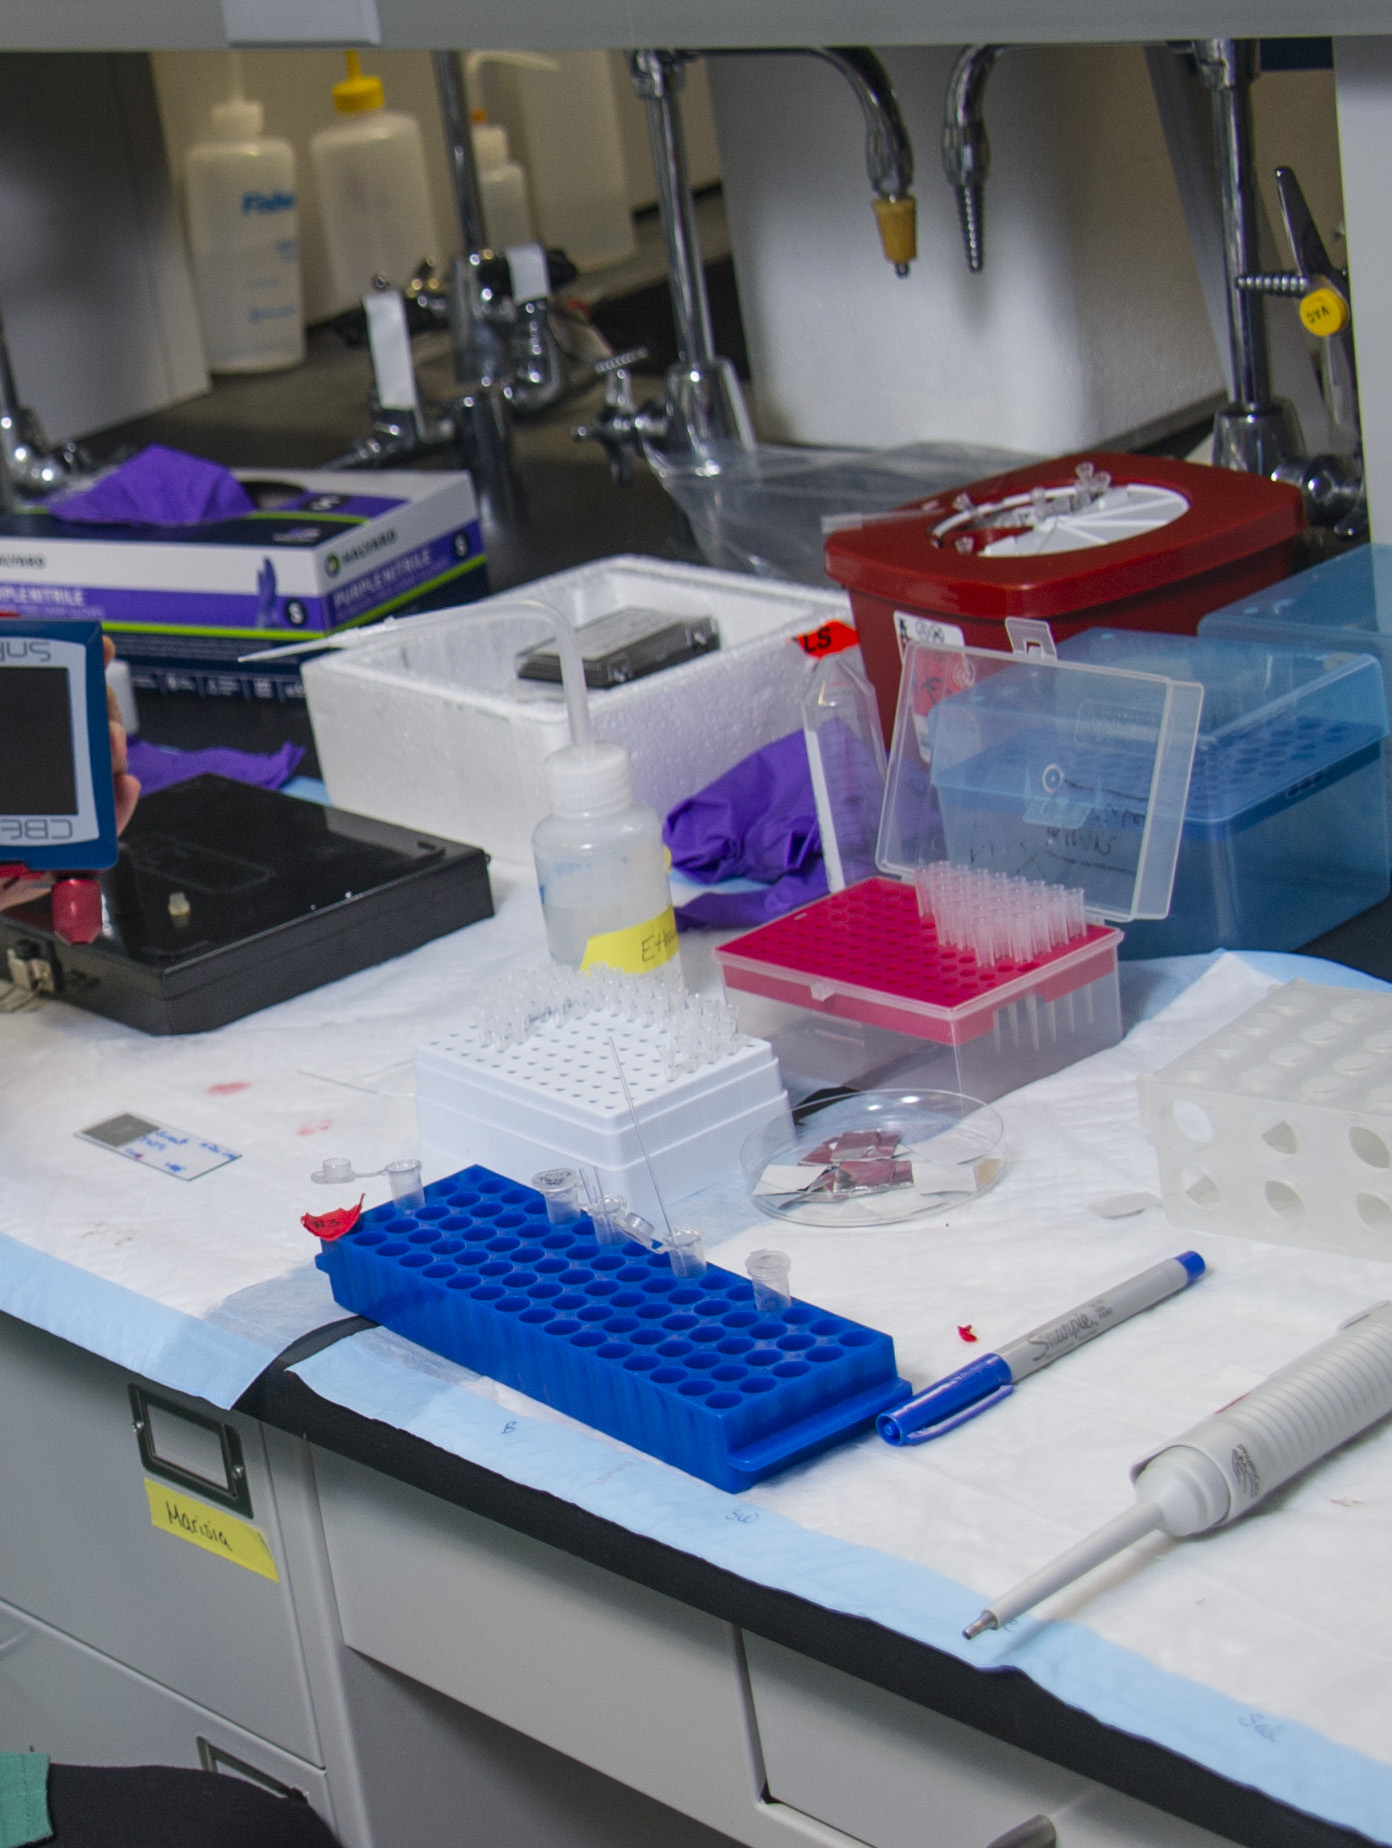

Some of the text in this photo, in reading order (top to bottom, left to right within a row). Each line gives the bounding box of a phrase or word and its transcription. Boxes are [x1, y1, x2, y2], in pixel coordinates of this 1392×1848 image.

[1305, 304, 1330, 324] VAC
[29, 587, 85, 607] NITRILE
[334, 571, 382, 607] PURPLE
[287, 601, 304, 624] S
[1028, 1313, 1094, 1361] Sharpie
